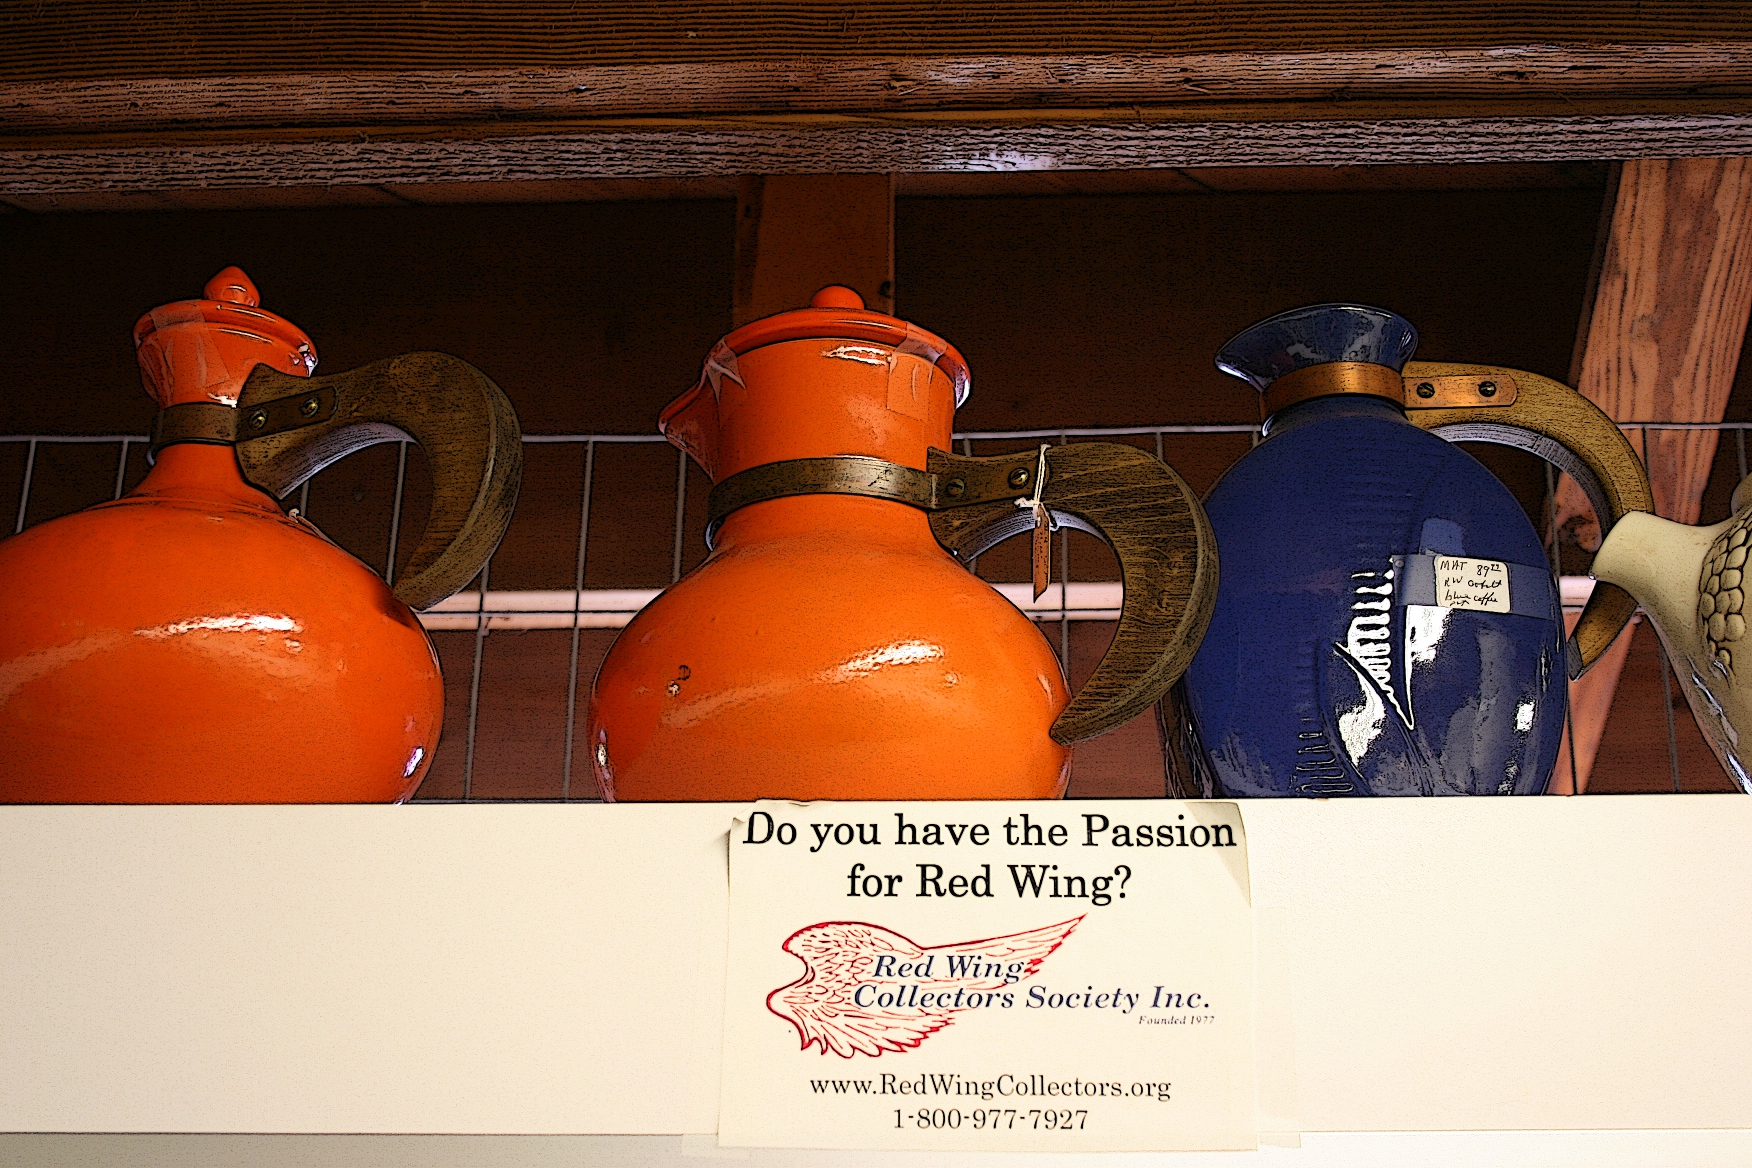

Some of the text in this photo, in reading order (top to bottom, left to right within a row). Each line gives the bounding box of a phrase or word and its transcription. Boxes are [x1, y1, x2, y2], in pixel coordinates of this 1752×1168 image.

[743, 811, 1238, 853] Do you have the Passion
[846, 862, 1132, 907] for Red Wing?
[873, 954, 1025, 984] Red Wing
[853, 984, 1211, 1014] Collectors Society Inc.
[1138, 1015, 1216, 1025] Founded 1977
[809, 1073, 1172, 1102] www.RedWingCollectors.org
[894, 1109, 1088, 1130] 1-800-977-7927
